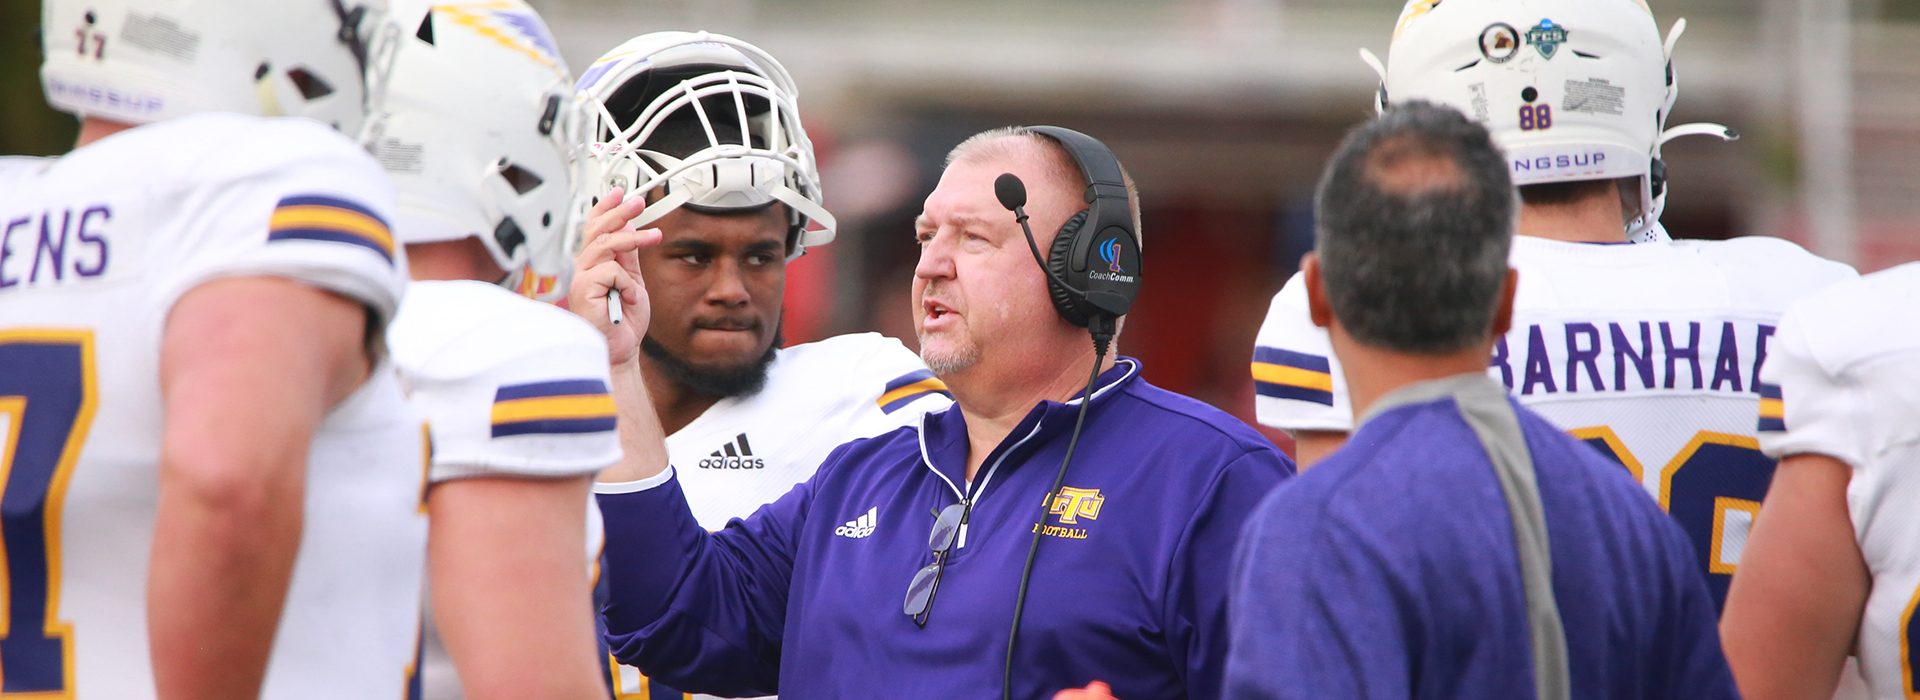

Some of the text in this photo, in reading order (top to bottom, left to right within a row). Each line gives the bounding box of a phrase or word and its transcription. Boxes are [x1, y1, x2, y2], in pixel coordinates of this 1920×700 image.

[1519, 102, 1552, 132] 88
[1089, 269, 1135, 283] CoachComm
[698, 451, 765, 470] adidas
[834, 525, 877, 540] adida
